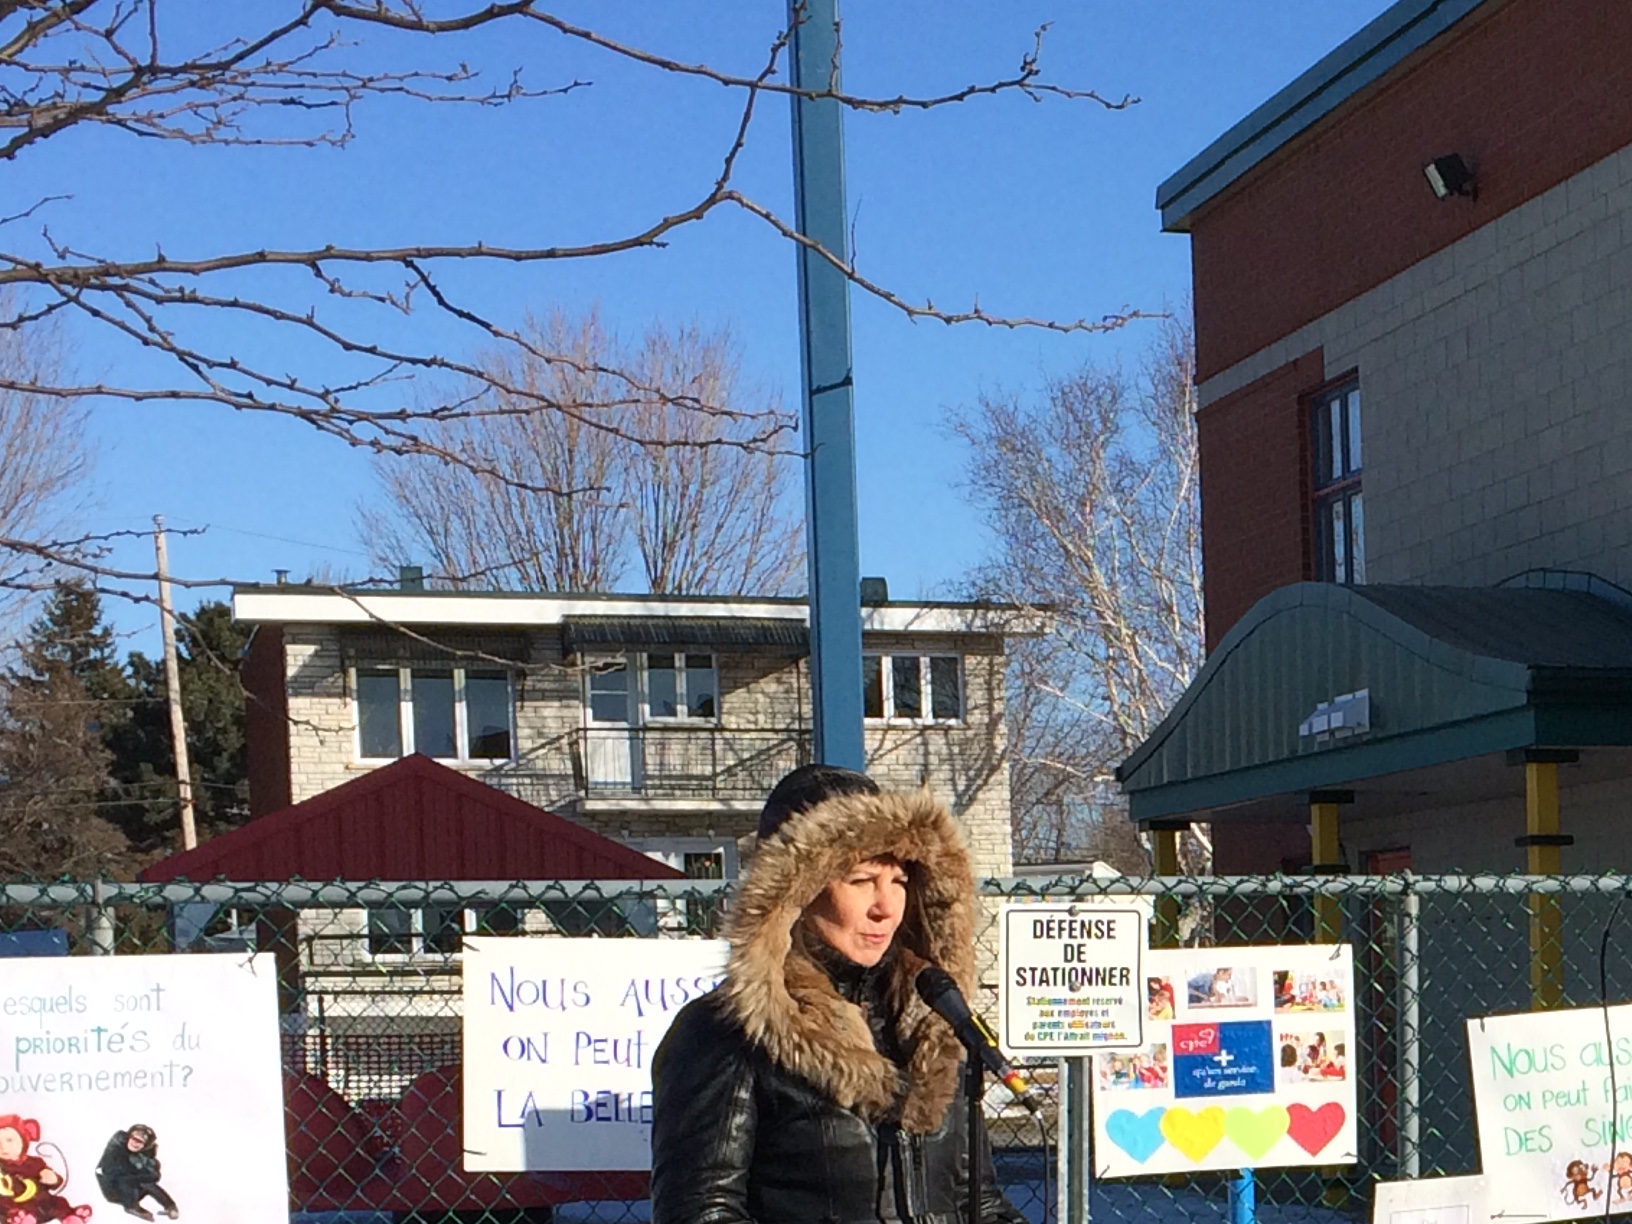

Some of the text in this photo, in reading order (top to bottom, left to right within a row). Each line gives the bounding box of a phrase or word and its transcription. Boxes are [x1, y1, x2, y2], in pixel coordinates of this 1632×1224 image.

[1033, 915, 1116, 939] DÉFENSE
[1063, 944, 1087, 963] DE
[490, 966, 719, 1017] NOUS AUSS
[1015, 967, 1130, 987] STATIONNER
[3, 982, 166, 1029] esquels sont
[172, 1021, 201, 1051] du
[502, 1032, 549, 1064] ON
[1037, 1032, 1055, 1041] CPE
[0, 1060, 194, 1094] ouvernement?
[1489, 1043, 1566, 1080] Nous
[494, 1089, 544, 1128] LA
[1542, 1080, 1590, 1109] peut
[1504, 1124, 1553, 1156] DES
